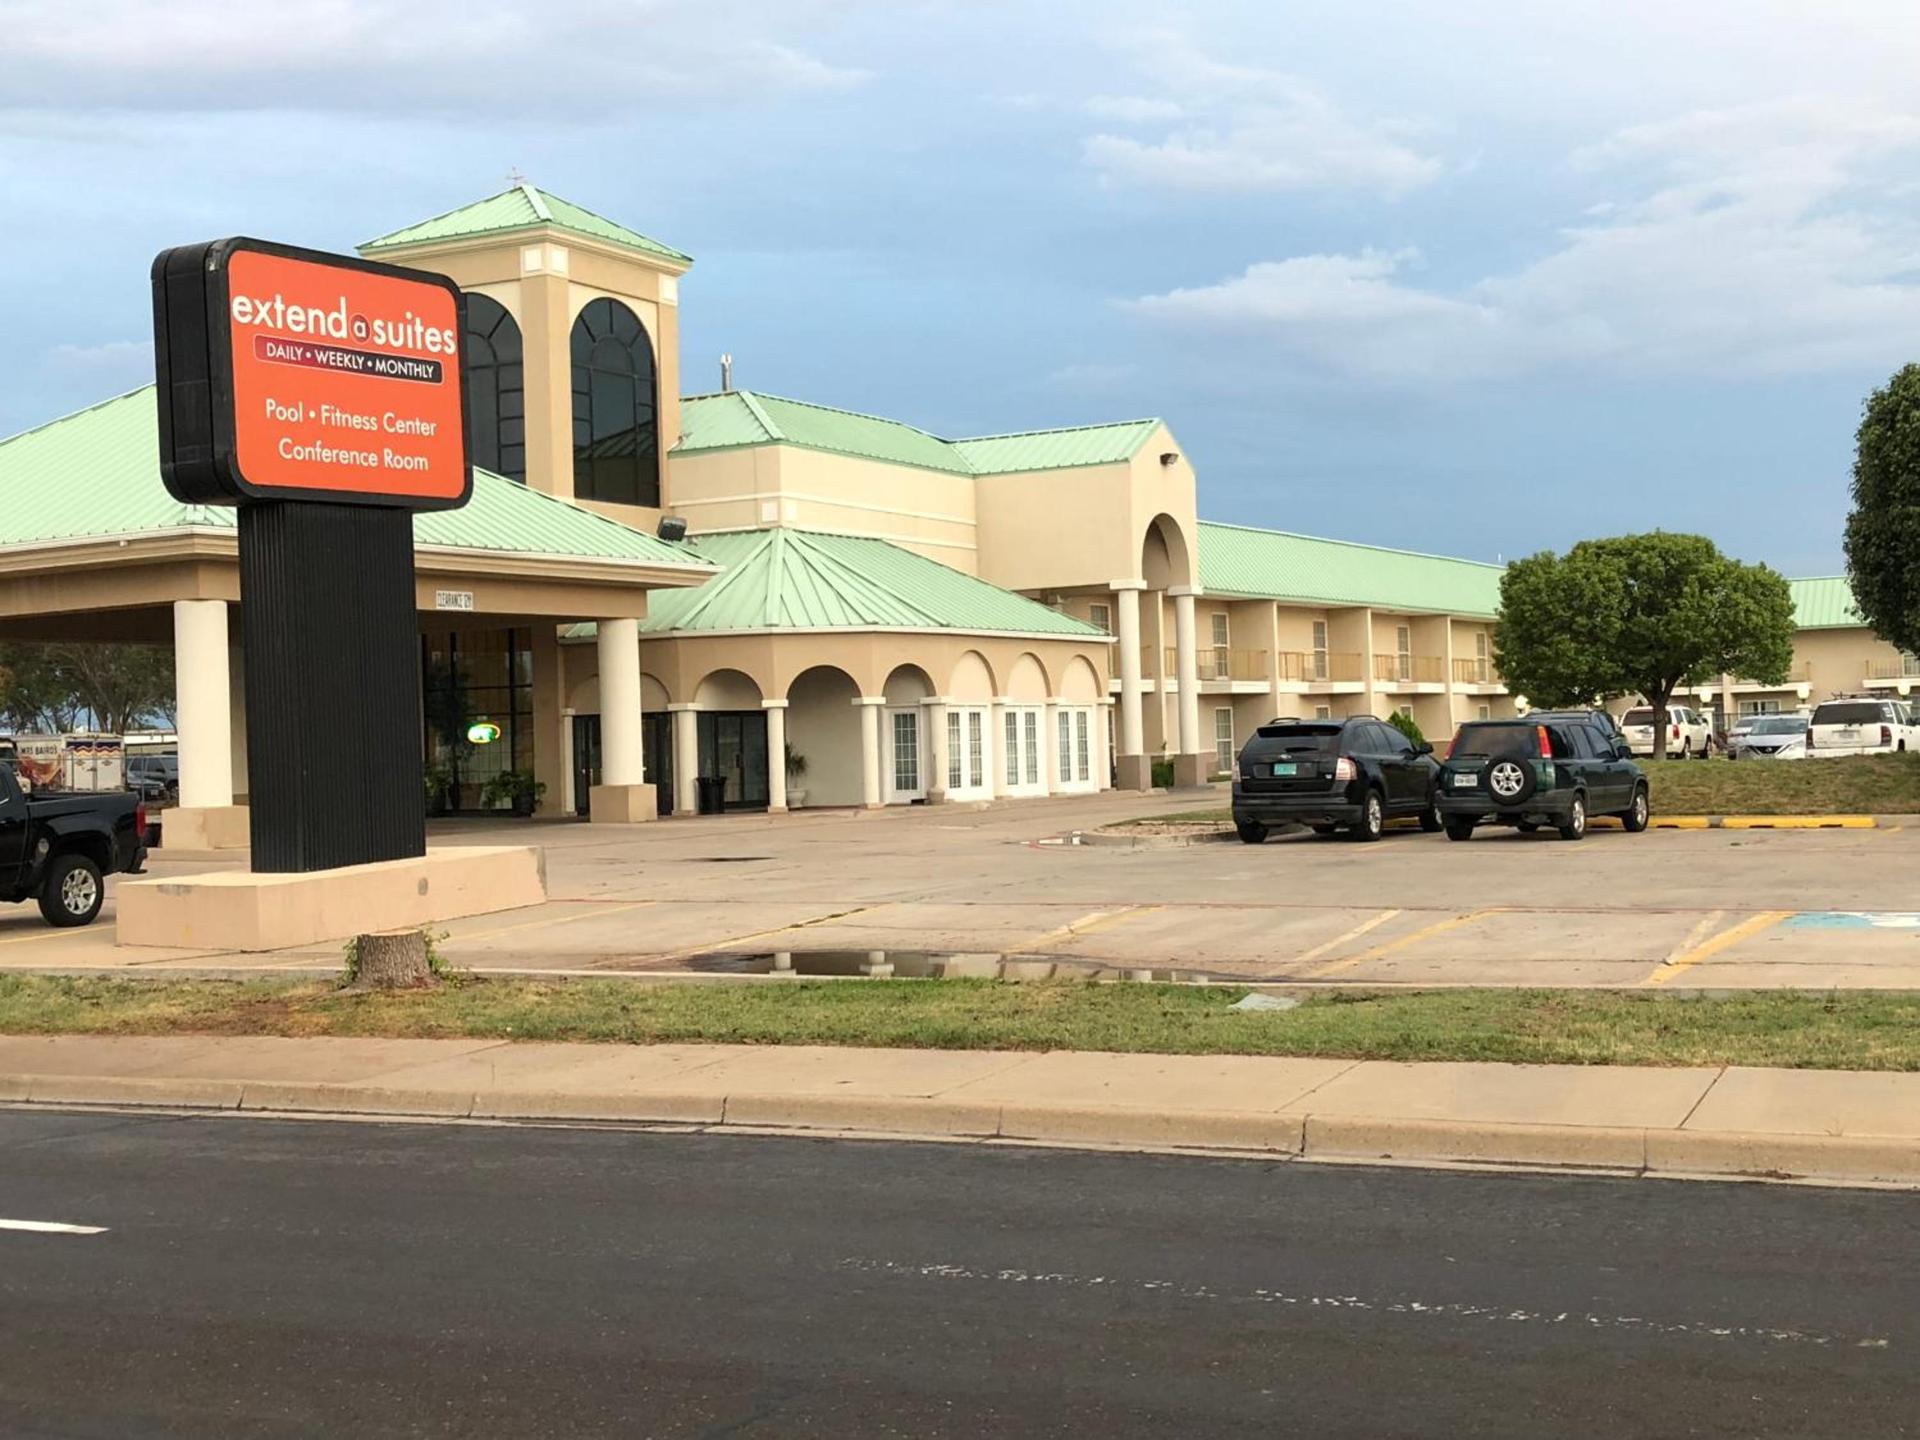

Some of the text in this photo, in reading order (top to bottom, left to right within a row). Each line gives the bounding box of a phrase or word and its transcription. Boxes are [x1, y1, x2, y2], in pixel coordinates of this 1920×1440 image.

[232, 294, 348, 339] extend
[372, 311, 457, 355] suites
[266, 342, 434, 379] DAILY WEEKLY MONTHLY
[265, 398, 437, 436] Pool Fitness Center
[278, 437, 429, 471] Conference Room
